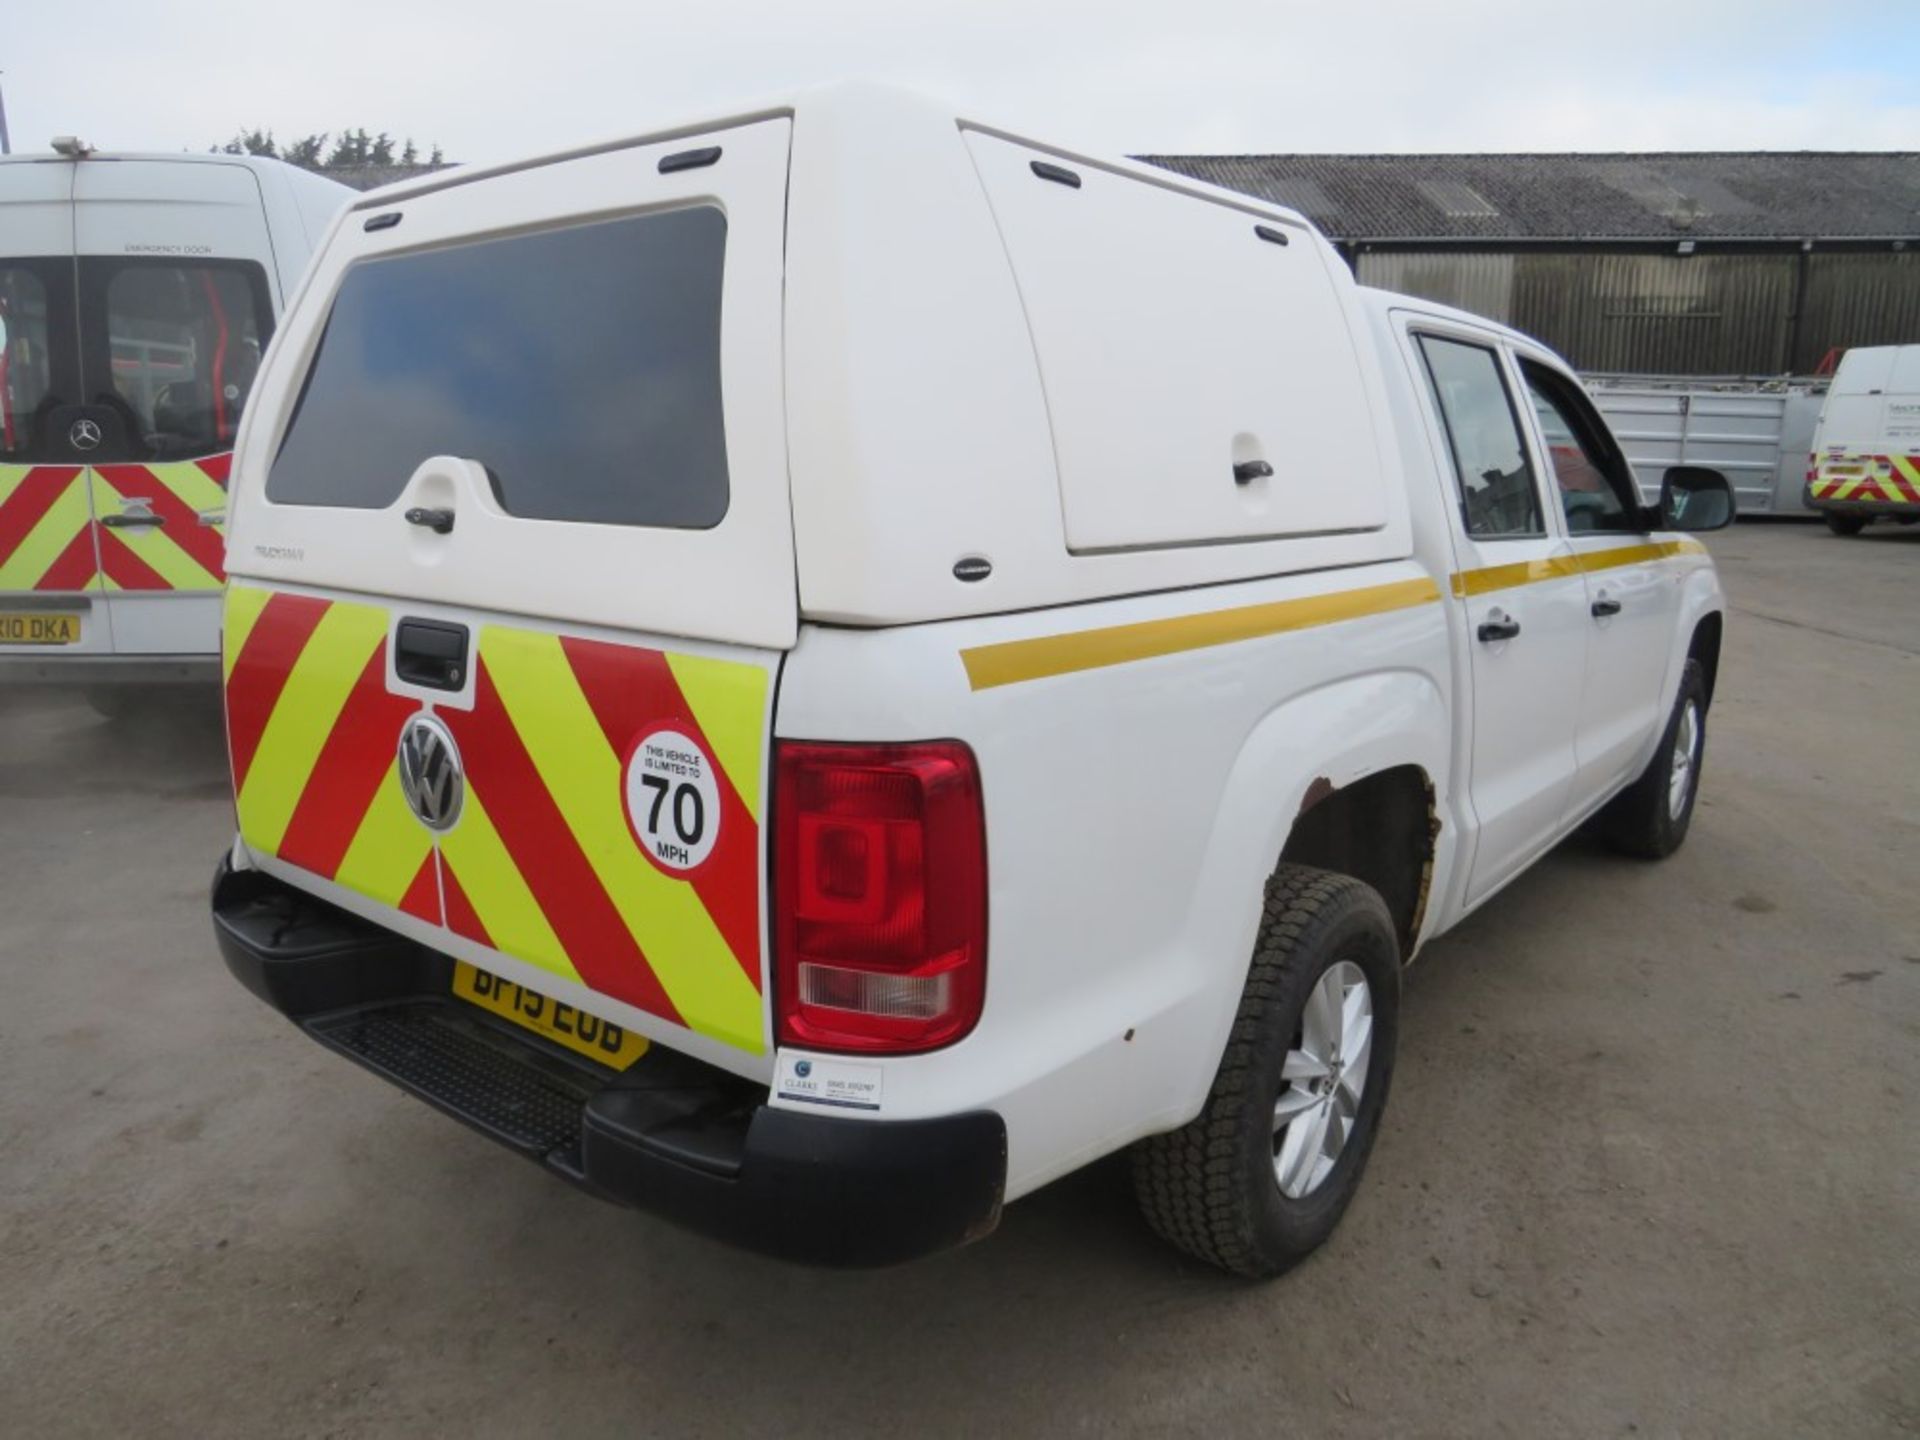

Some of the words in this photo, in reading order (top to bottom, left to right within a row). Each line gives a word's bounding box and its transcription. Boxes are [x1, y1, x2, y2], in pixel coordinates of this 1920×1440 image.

[30, 619, 71, 639] DKA
[646, 744, 664, 758] THIS
[665, 750, 700, 767] VEHICLE
[645, 758, 653, 768] IS
[654, 760, 687, 776] LIMITED
[688, 767, 701, 778] TO
[641, 773, 704, 845] 70
[656, 842, 689, 864] MPH
